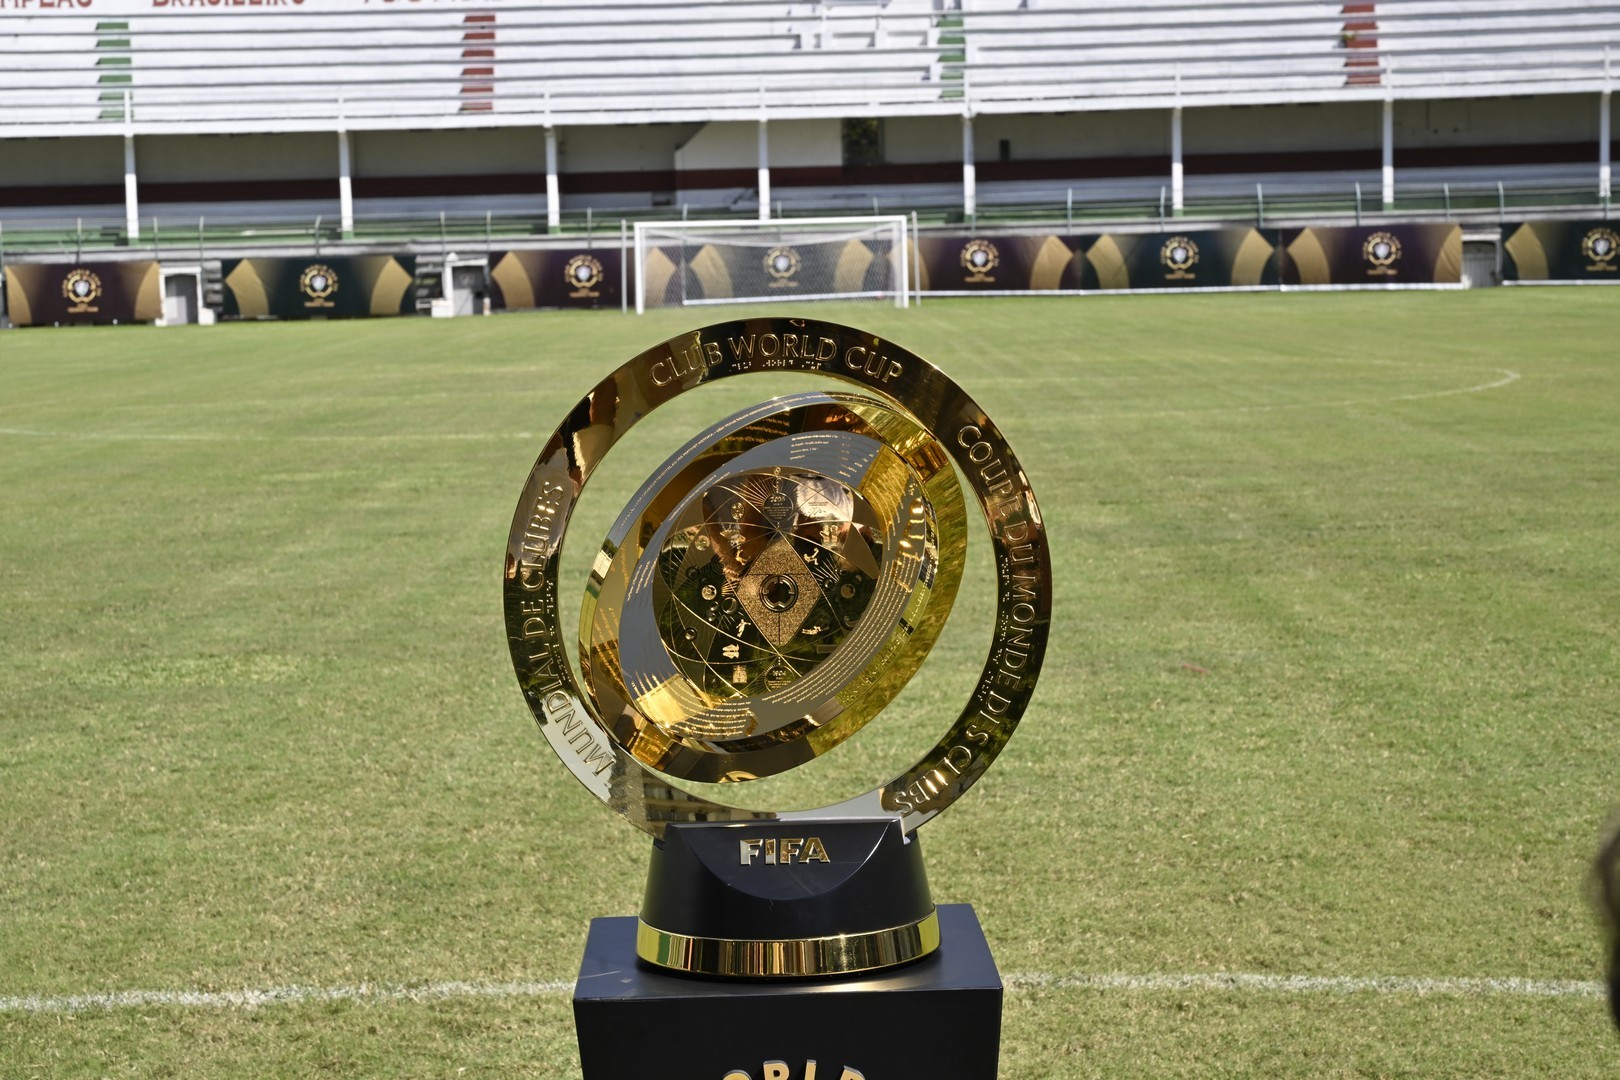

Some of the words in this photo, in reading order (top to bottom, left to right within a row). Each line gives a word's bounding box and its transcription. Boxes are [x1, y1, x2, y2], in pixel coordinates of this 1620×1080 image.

[650, 342, 724, 387] CLUB
[727, 333, 837, 362] WORLD
[845, 346, 904, 384] CUP
[957, 425, 1024, 518] COUPE
[520, 481, 564, 592] CLUBES
[1003, 520, 1035, 566] DU
[522, 600, 548, 639] DE
[997, 574, 1036, 690] MONDE
[528, 642, 617, 777] MUNDIAL
[966, 690, 1012, 746] DES
[895, 745, 973, 816] CLUBS
[740, 837, 831, 865] FIFA
